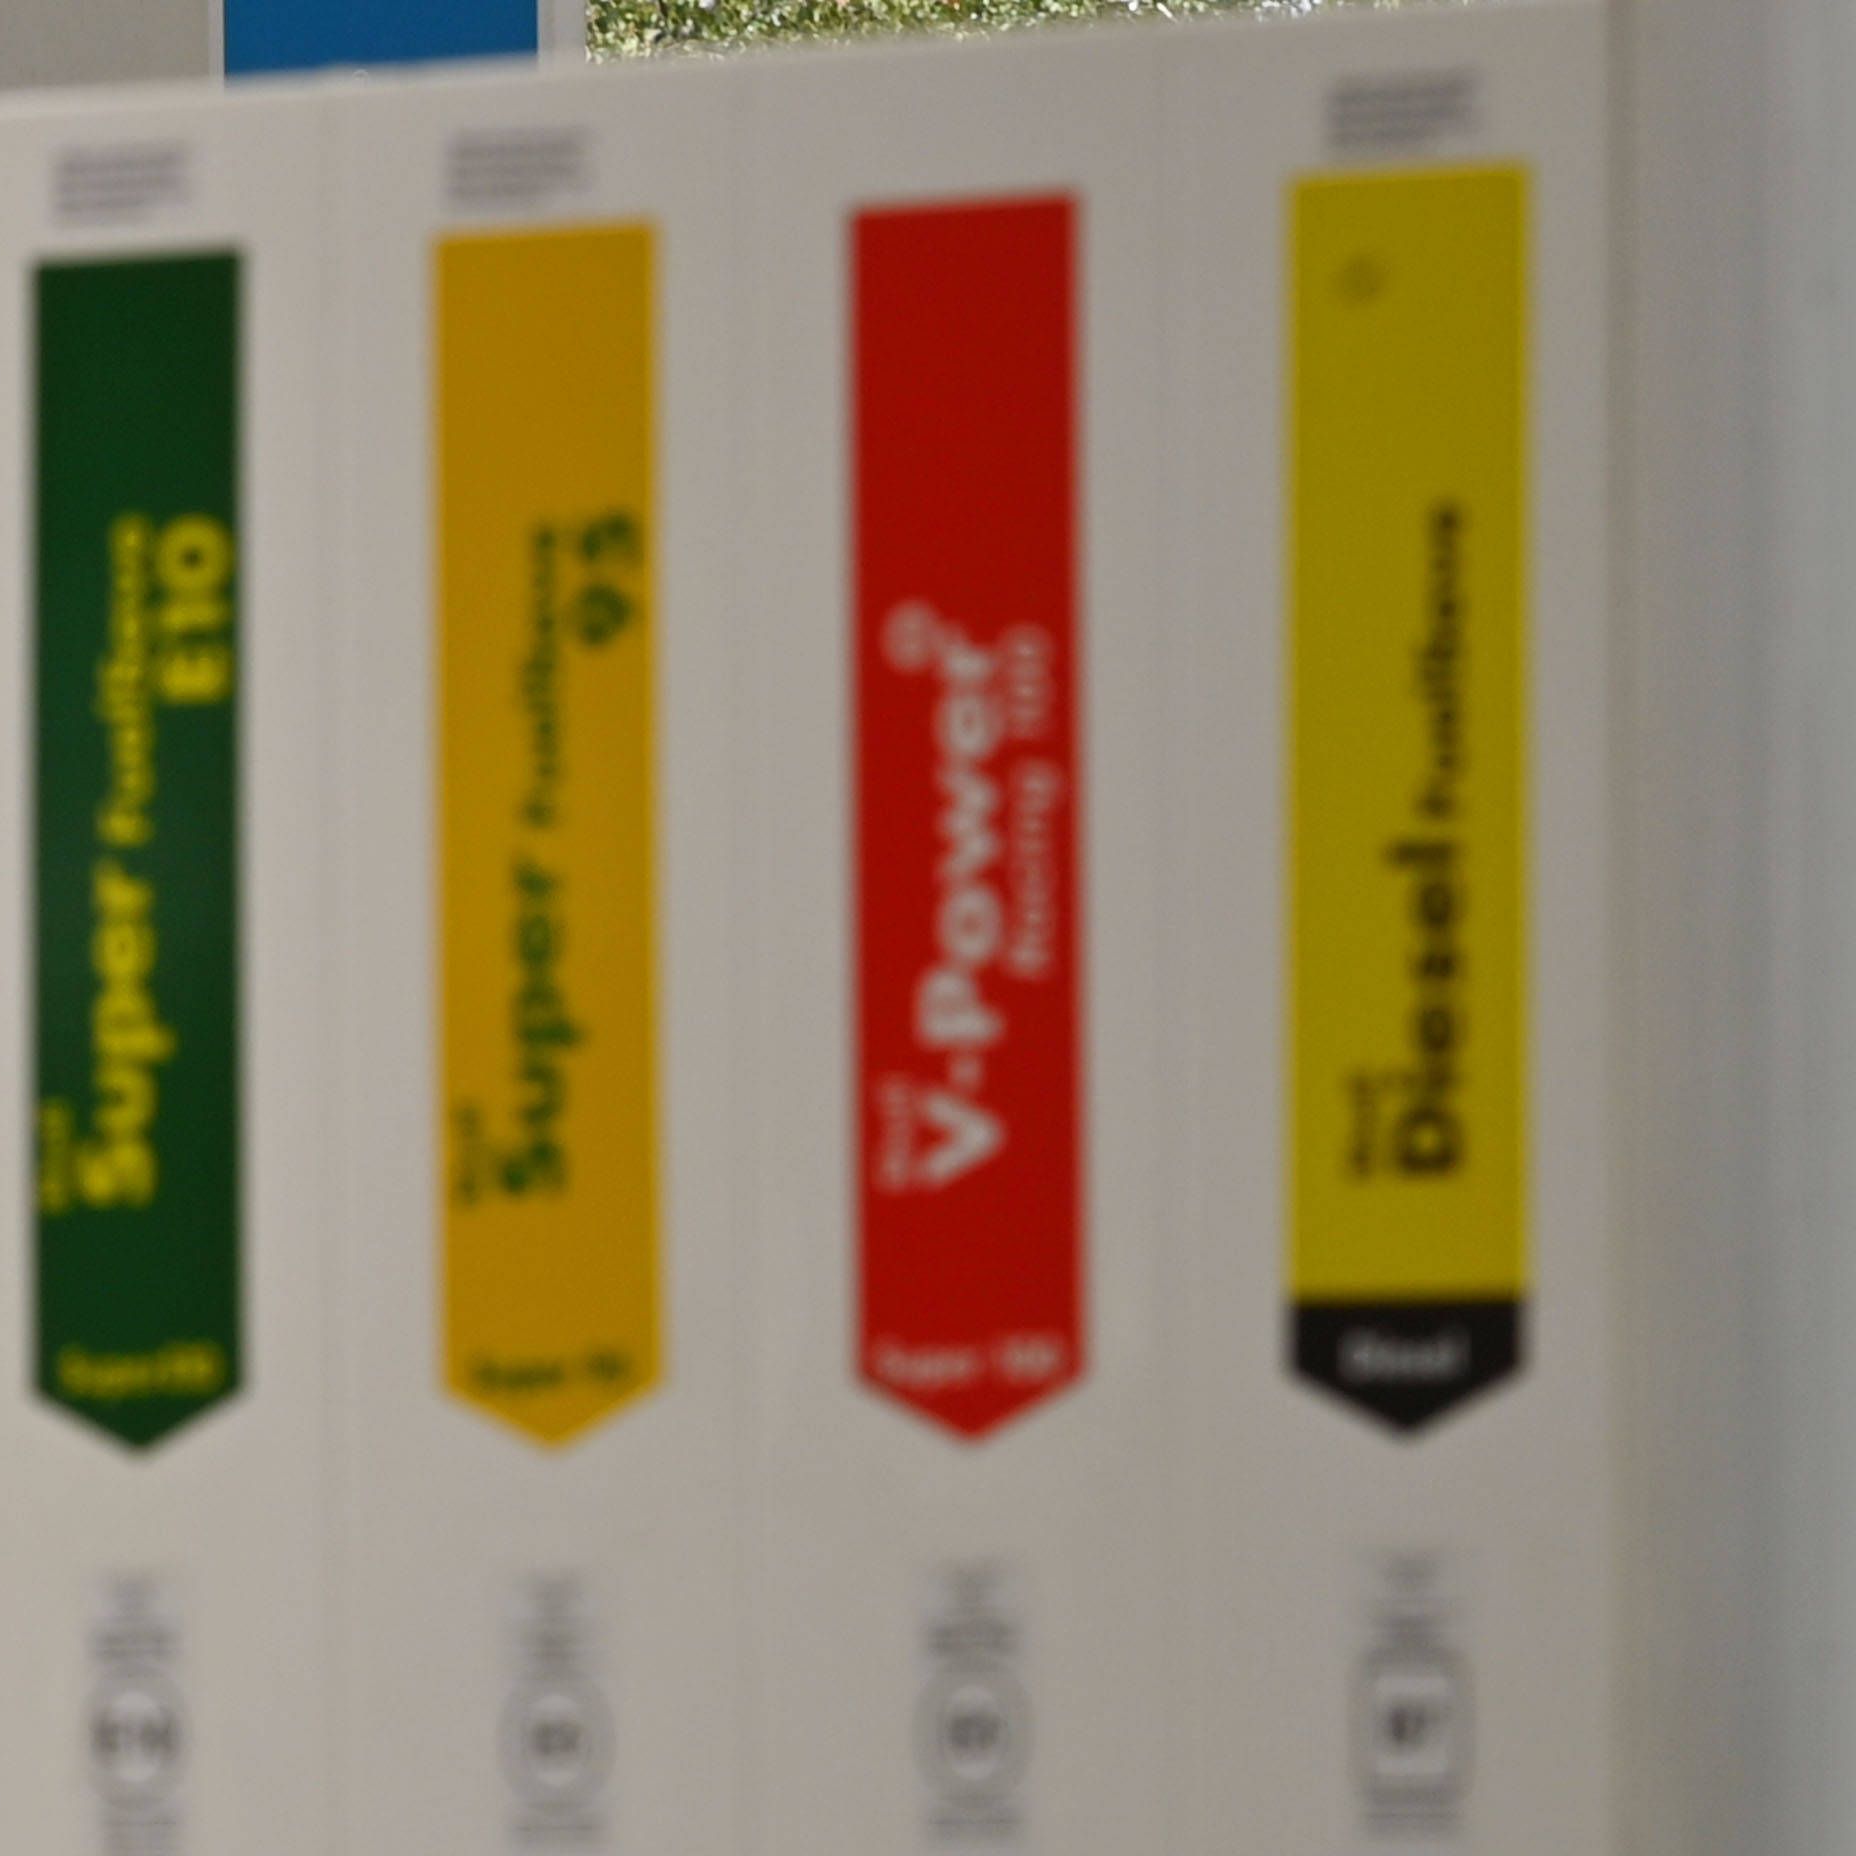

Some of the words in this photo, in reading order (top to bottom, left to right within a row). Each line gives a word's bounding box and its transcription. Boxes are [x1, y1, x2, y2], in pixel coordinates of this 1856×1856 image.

[157, 513, 233, 703] E10
[78, 860, 176, 1208] Super
[500, 858, 585, 1192] Super
[1386, 838, 1466, 1177] Diesel
